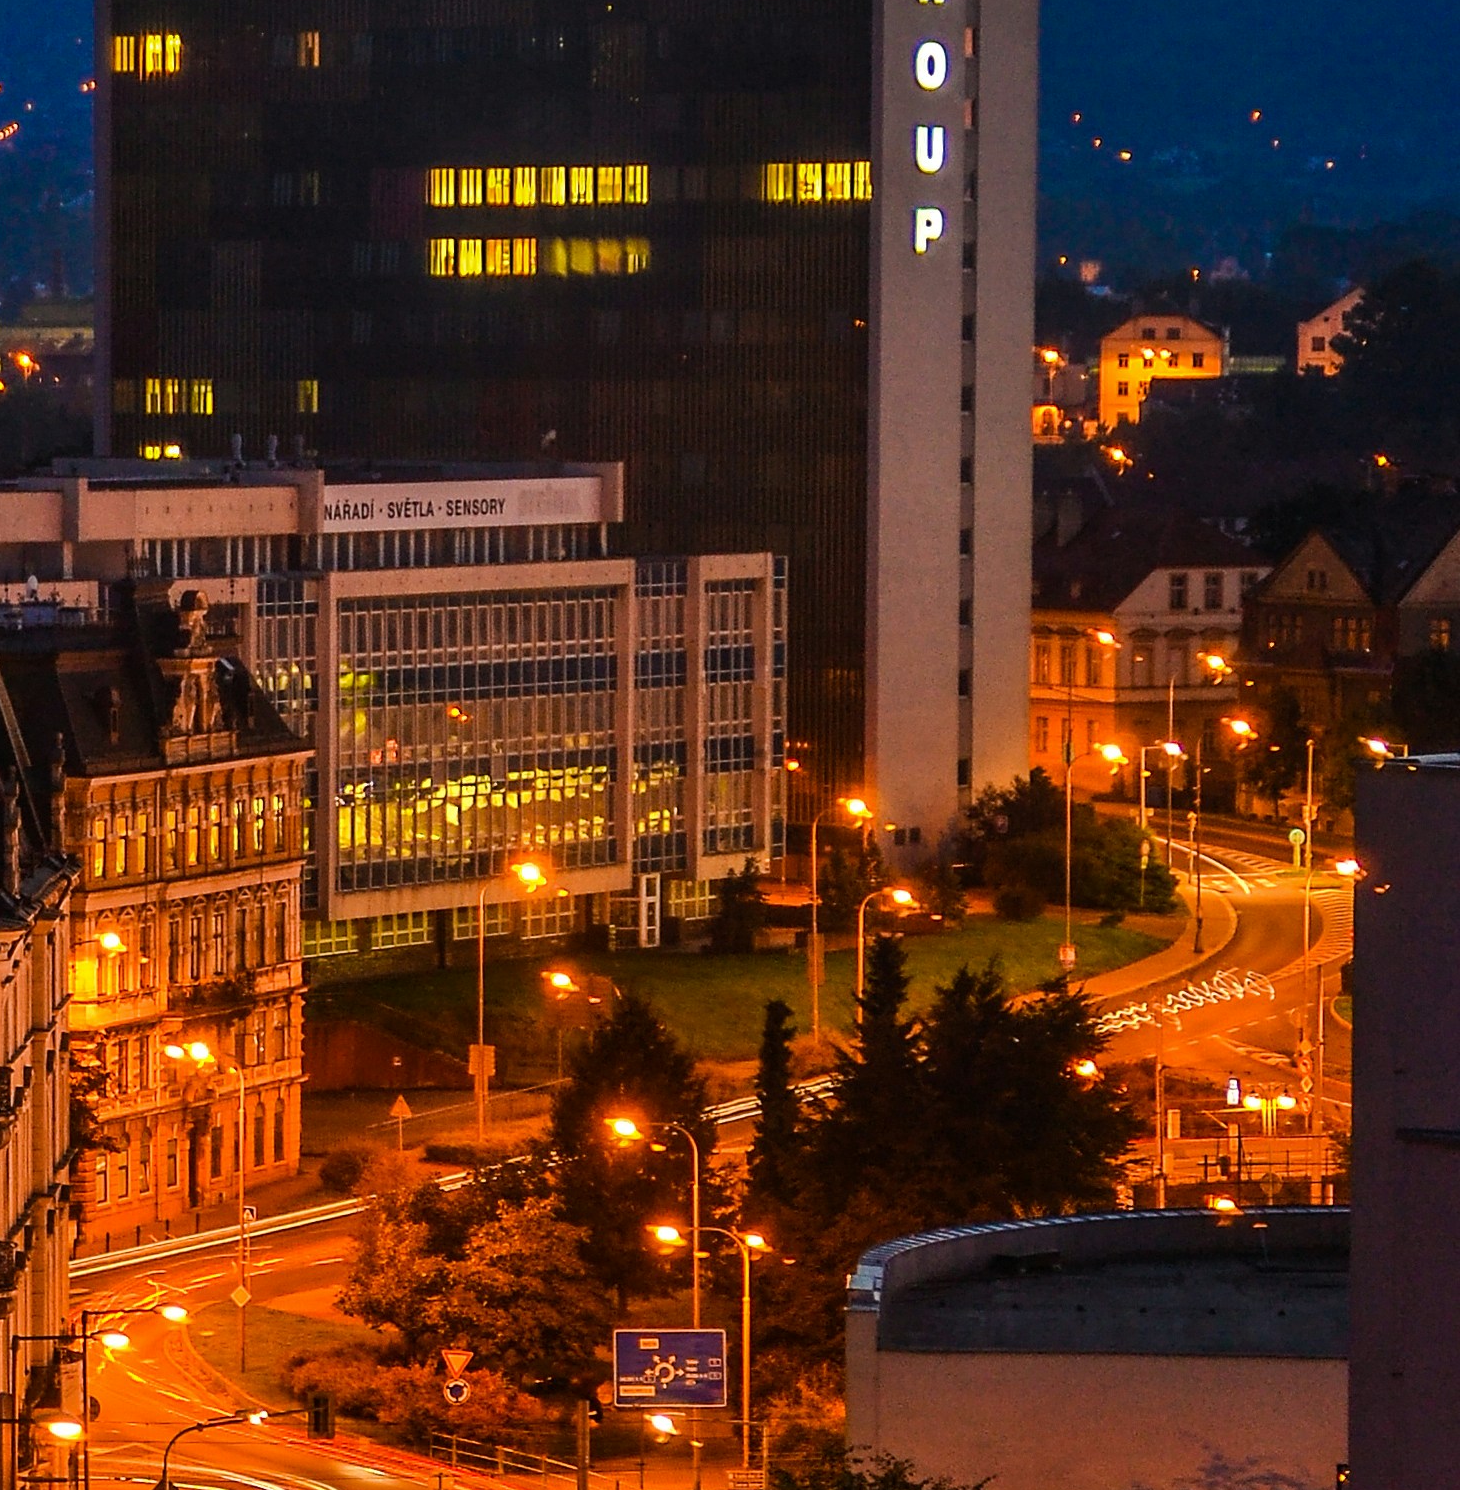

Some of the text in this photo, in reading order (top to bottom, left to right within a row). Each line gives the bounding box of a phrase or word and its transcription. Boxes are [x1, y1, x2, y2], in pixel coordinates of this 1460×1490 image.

[324, 498, 375, 521] NÁŘADÍ
[387, 497, 435, 519] SVĚTLA
[446, 497, 506, 517] SENSORY
